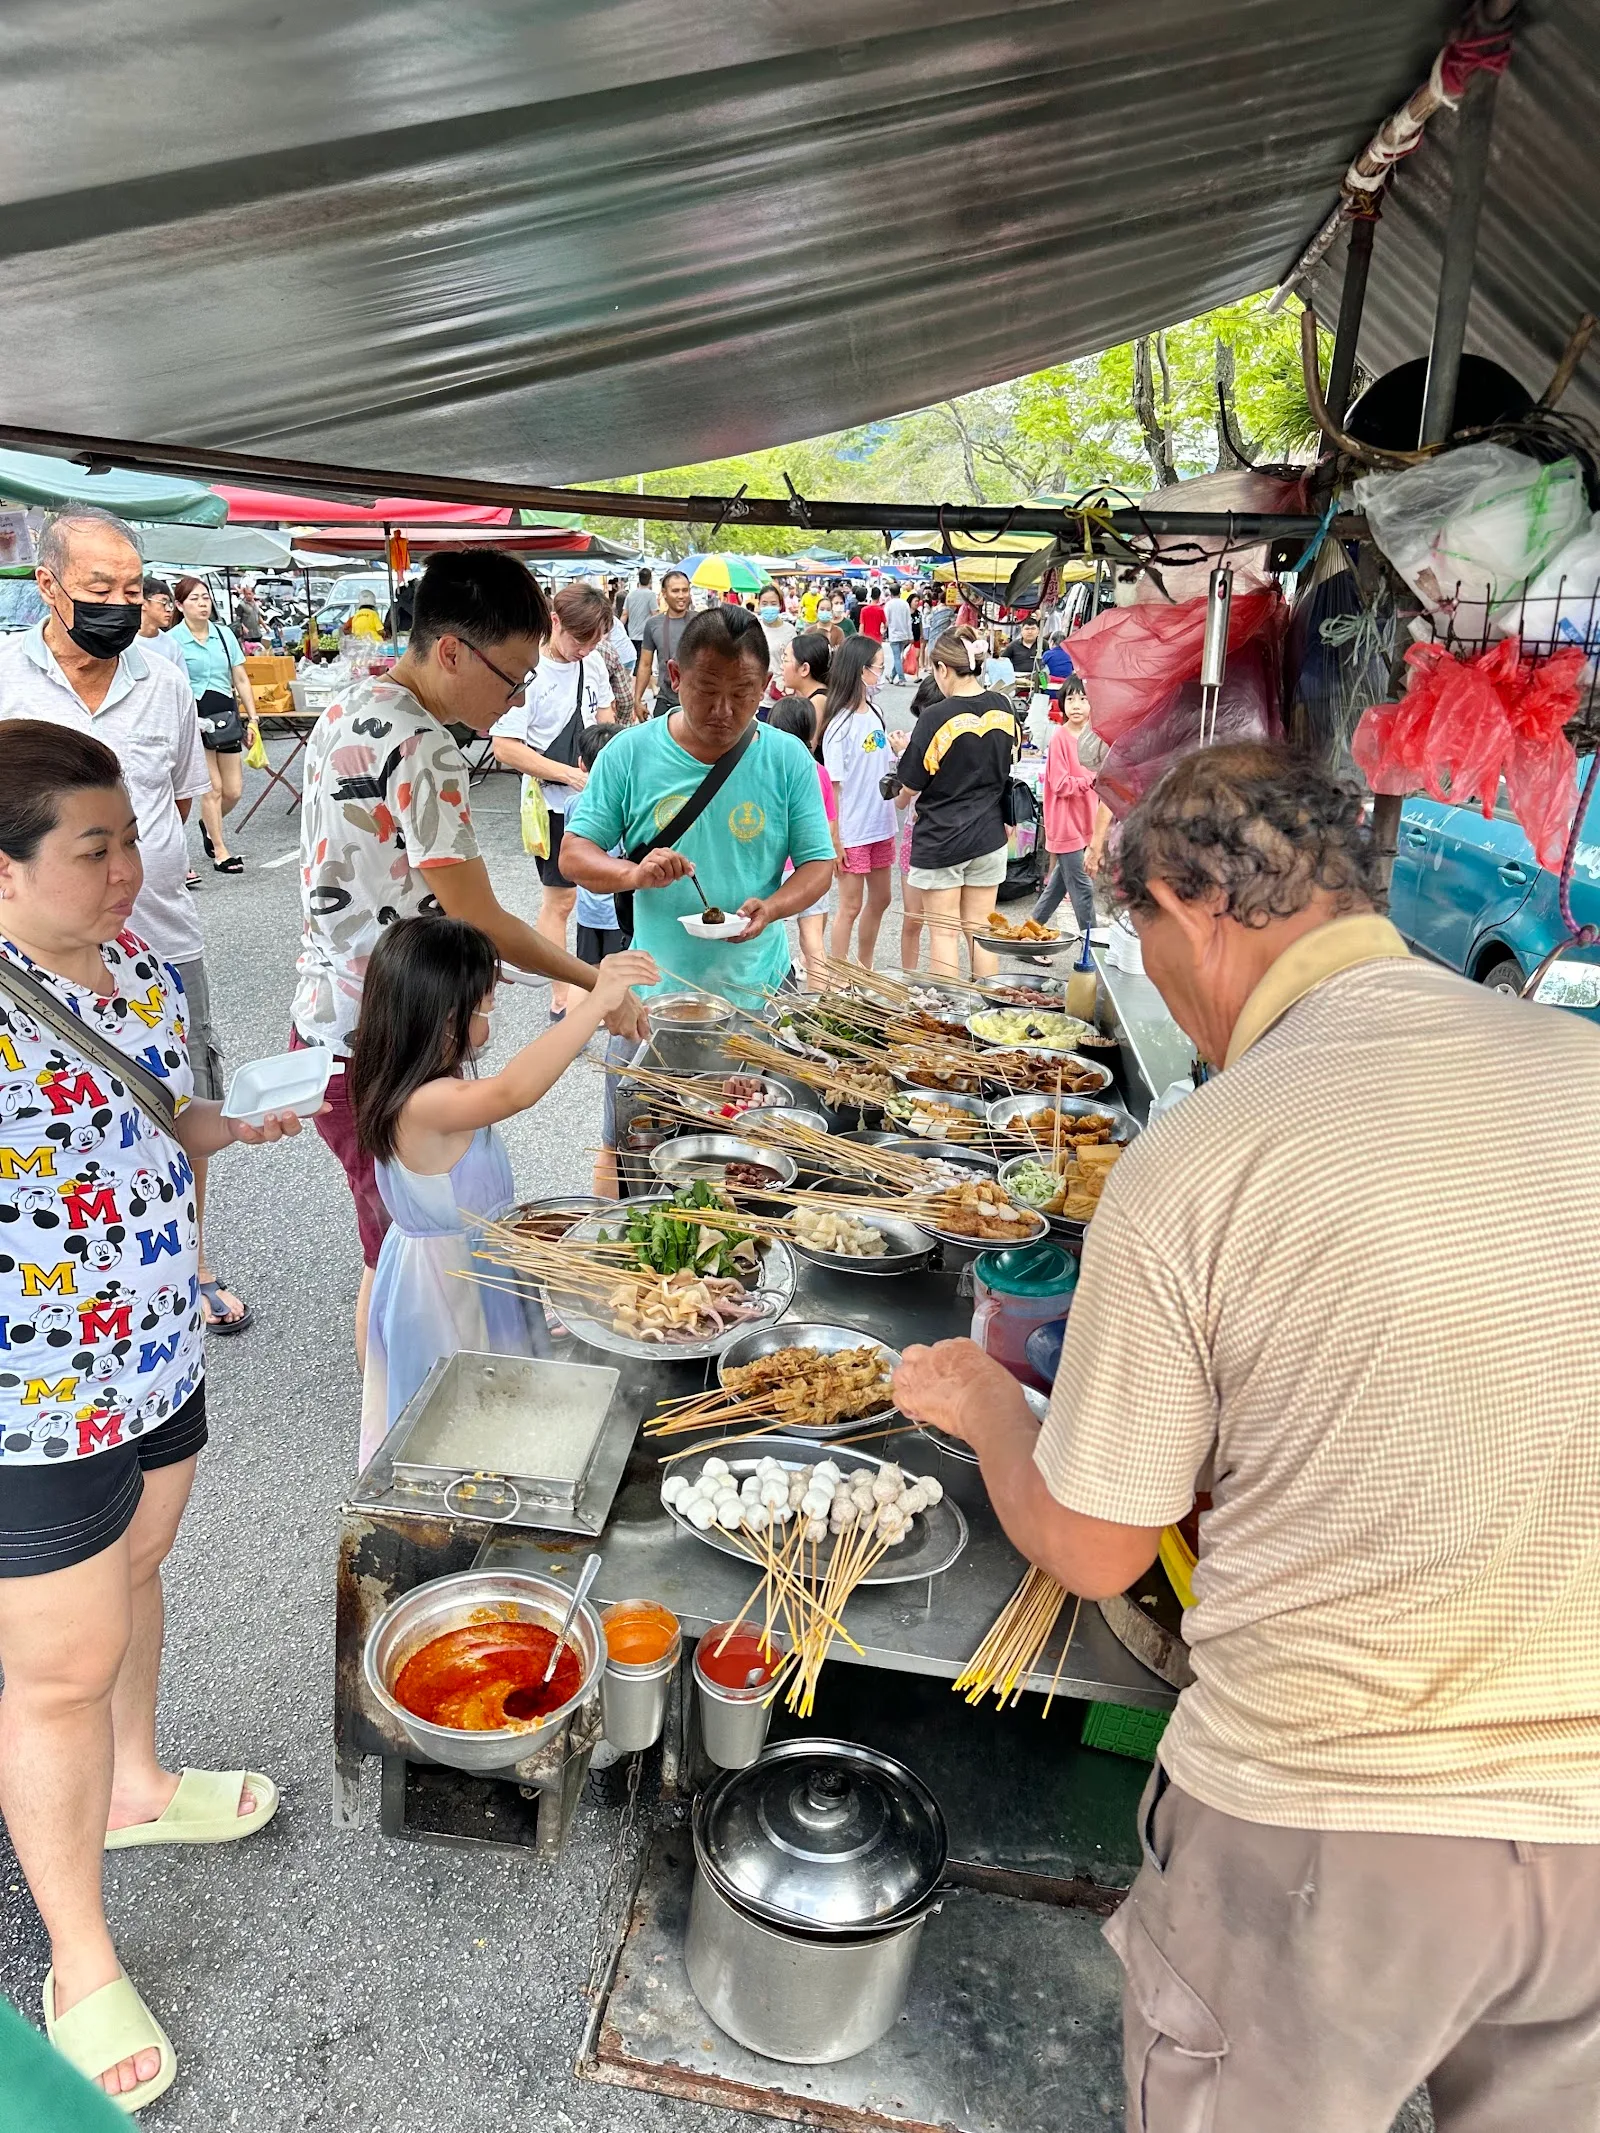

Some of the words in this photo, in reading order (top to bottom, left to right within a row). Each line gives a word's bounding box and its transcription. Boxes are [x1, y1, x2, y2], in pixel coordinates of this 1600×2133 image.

[116, 928, 150, 958] M
[42, 1072, 109, 1115] M
[0, 1146, 57, 1179] M
[62, 1187, 122, 1229] M
[19, 1261, 78, 1296] M
[79, 1305, 133, 1345] M
[20, 1377, 80, 1405] M
[75, 1413, 125, 1455] M
